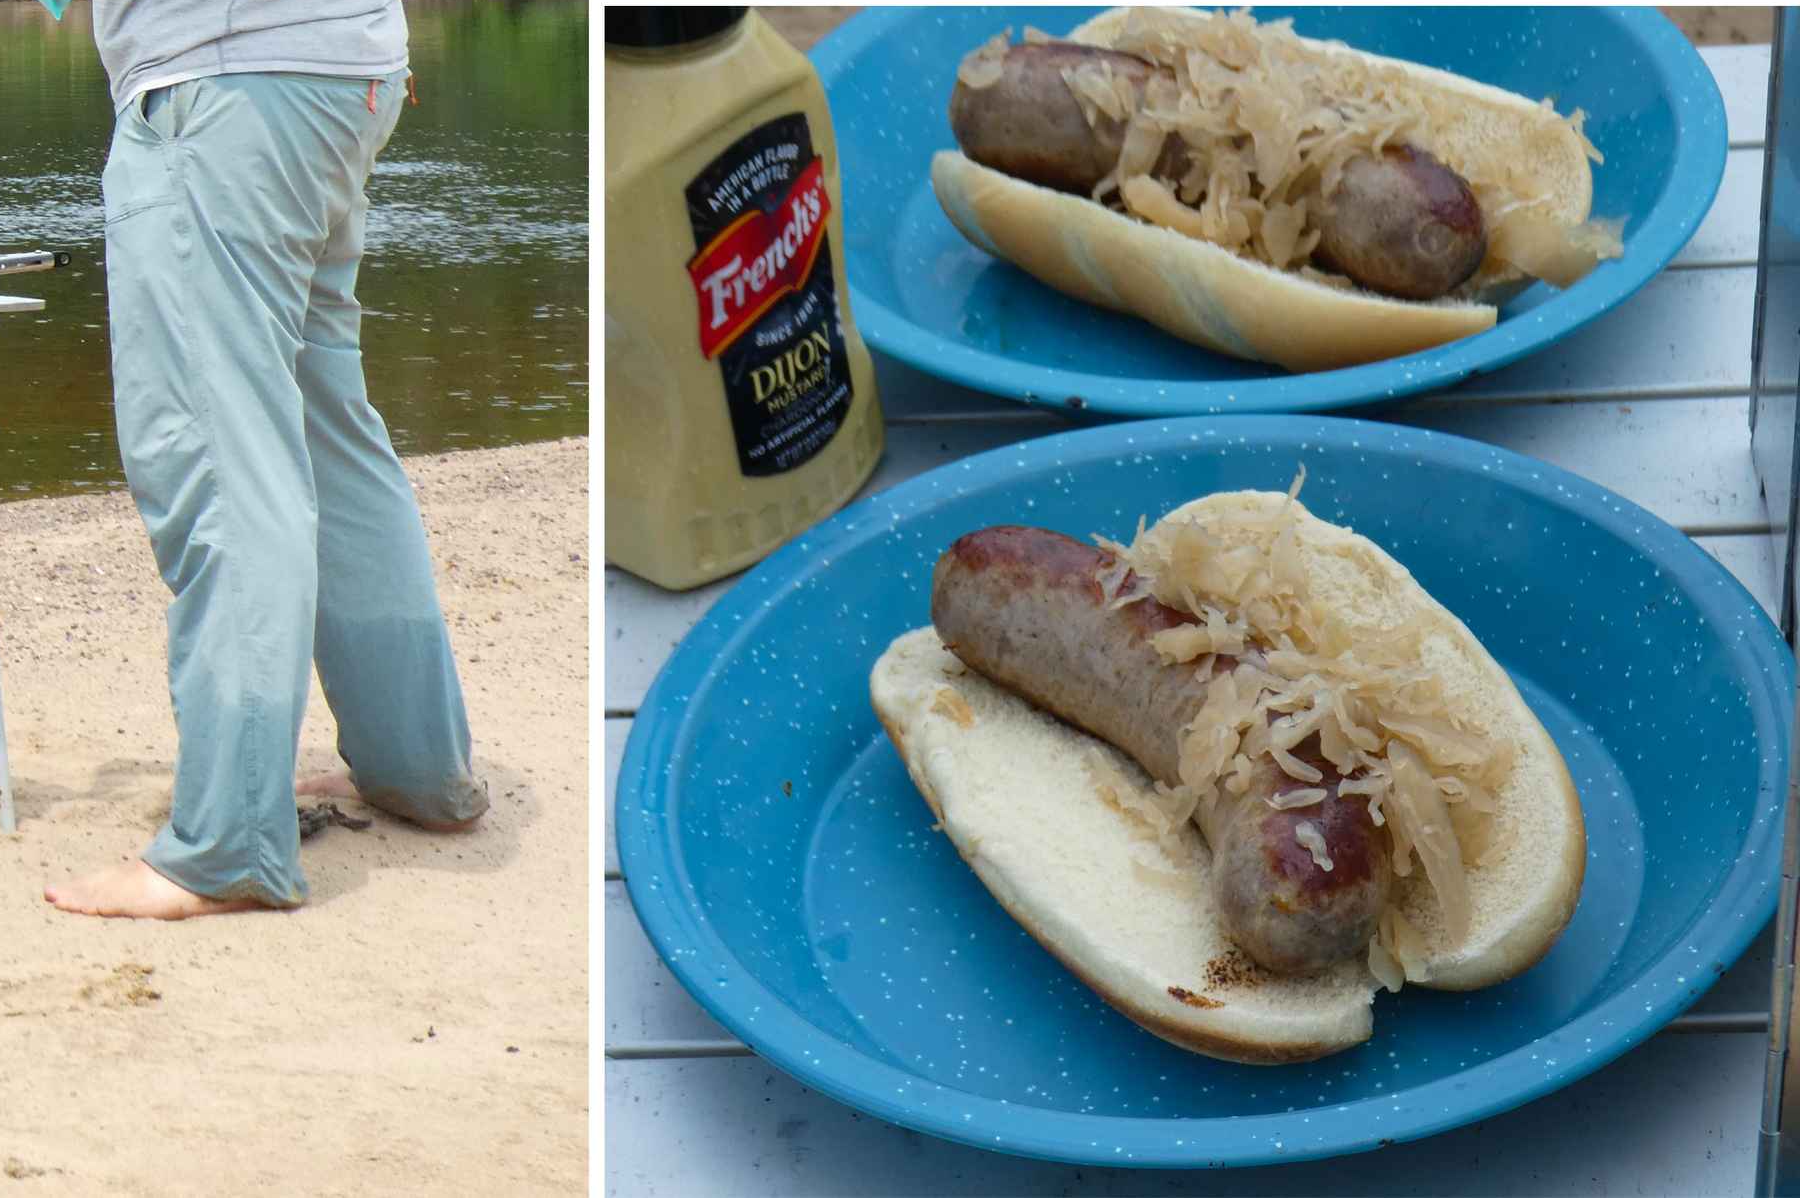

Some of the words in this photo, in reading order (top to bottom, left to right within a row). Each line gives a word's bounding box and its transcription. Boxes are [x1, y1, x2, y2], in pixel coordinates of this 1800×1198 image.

[707, 154, 764, 213] AMERICAN
[764, 143, 799, 165] FLAVOR
[726, 195, 743, 213] IN
[741, 186, 752, 201] A
[751, 162, 790, 192] BOTTLE
[701, 188, 821, 330] French's
[750, 322, 831, 404] DIJON
[755, 321, 792, 347] SINCE
